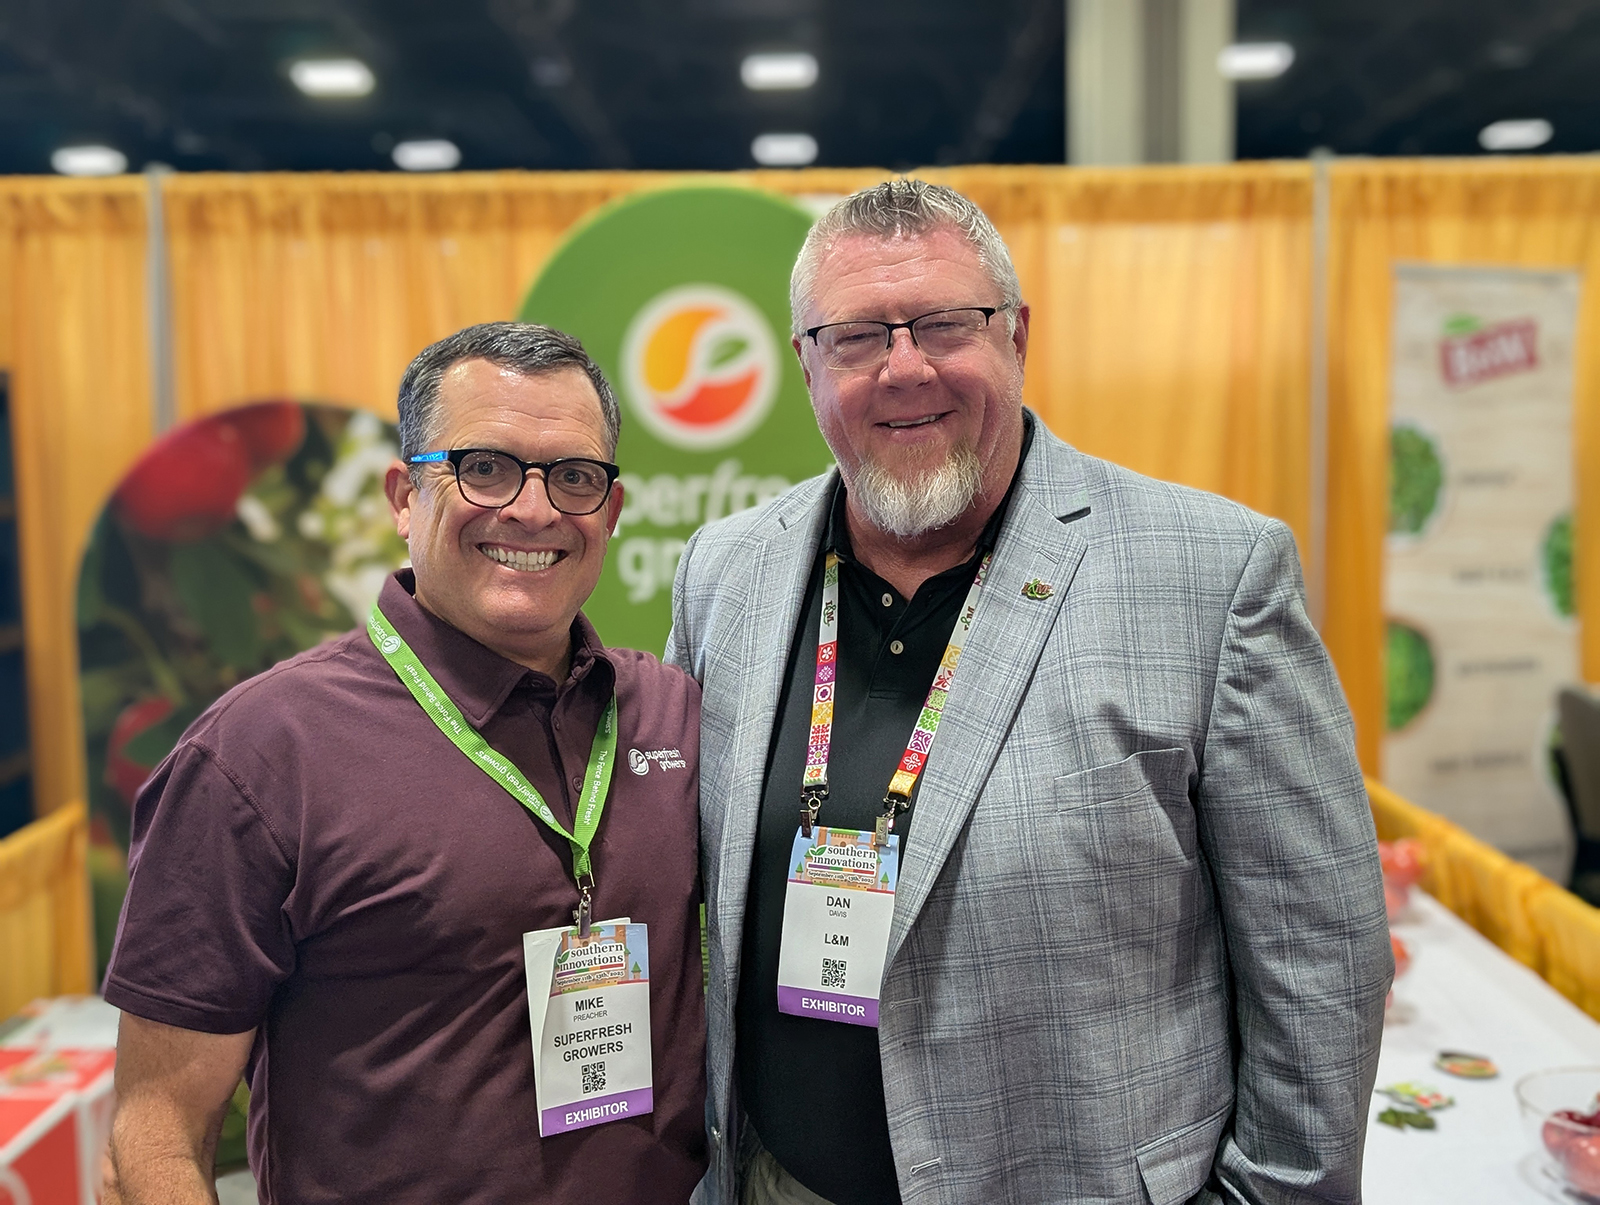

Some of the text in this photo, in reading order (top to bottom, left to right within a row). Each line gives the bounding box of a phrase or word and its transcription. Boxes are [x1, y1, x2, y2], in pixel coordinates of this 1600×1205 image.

[418, 681, 438, 704] Behind
[434, 701, 453, 722] Force
[449, 719, 463, 735] The
[599, 750, 608, 761] The
[595, 761, 606, 779] Force
[589, 780, 602, 803] Behind
[828, 845, 876, 859] southern
[814, 857, 876, 870] innovations
[826, 895, 851, 909] DAN
[829, 909, 848, 918] DAVIS
[824, 933, 849, 947] L&M
[571, 943, 624, 958] southern
[560, 954, 624, 971] innovations
[575, 996, 604, 1012] MIKE
[801, 997, 865, 1017] EXHIBITOR
[573, 1009, 608, 1022] PREACHER
[553, 1022, 632, 1048] SUPERFRESH
[563, 1040, 624, 1063] GROWERS
[565, 1100, 629, 1125] EXHIBITOR
